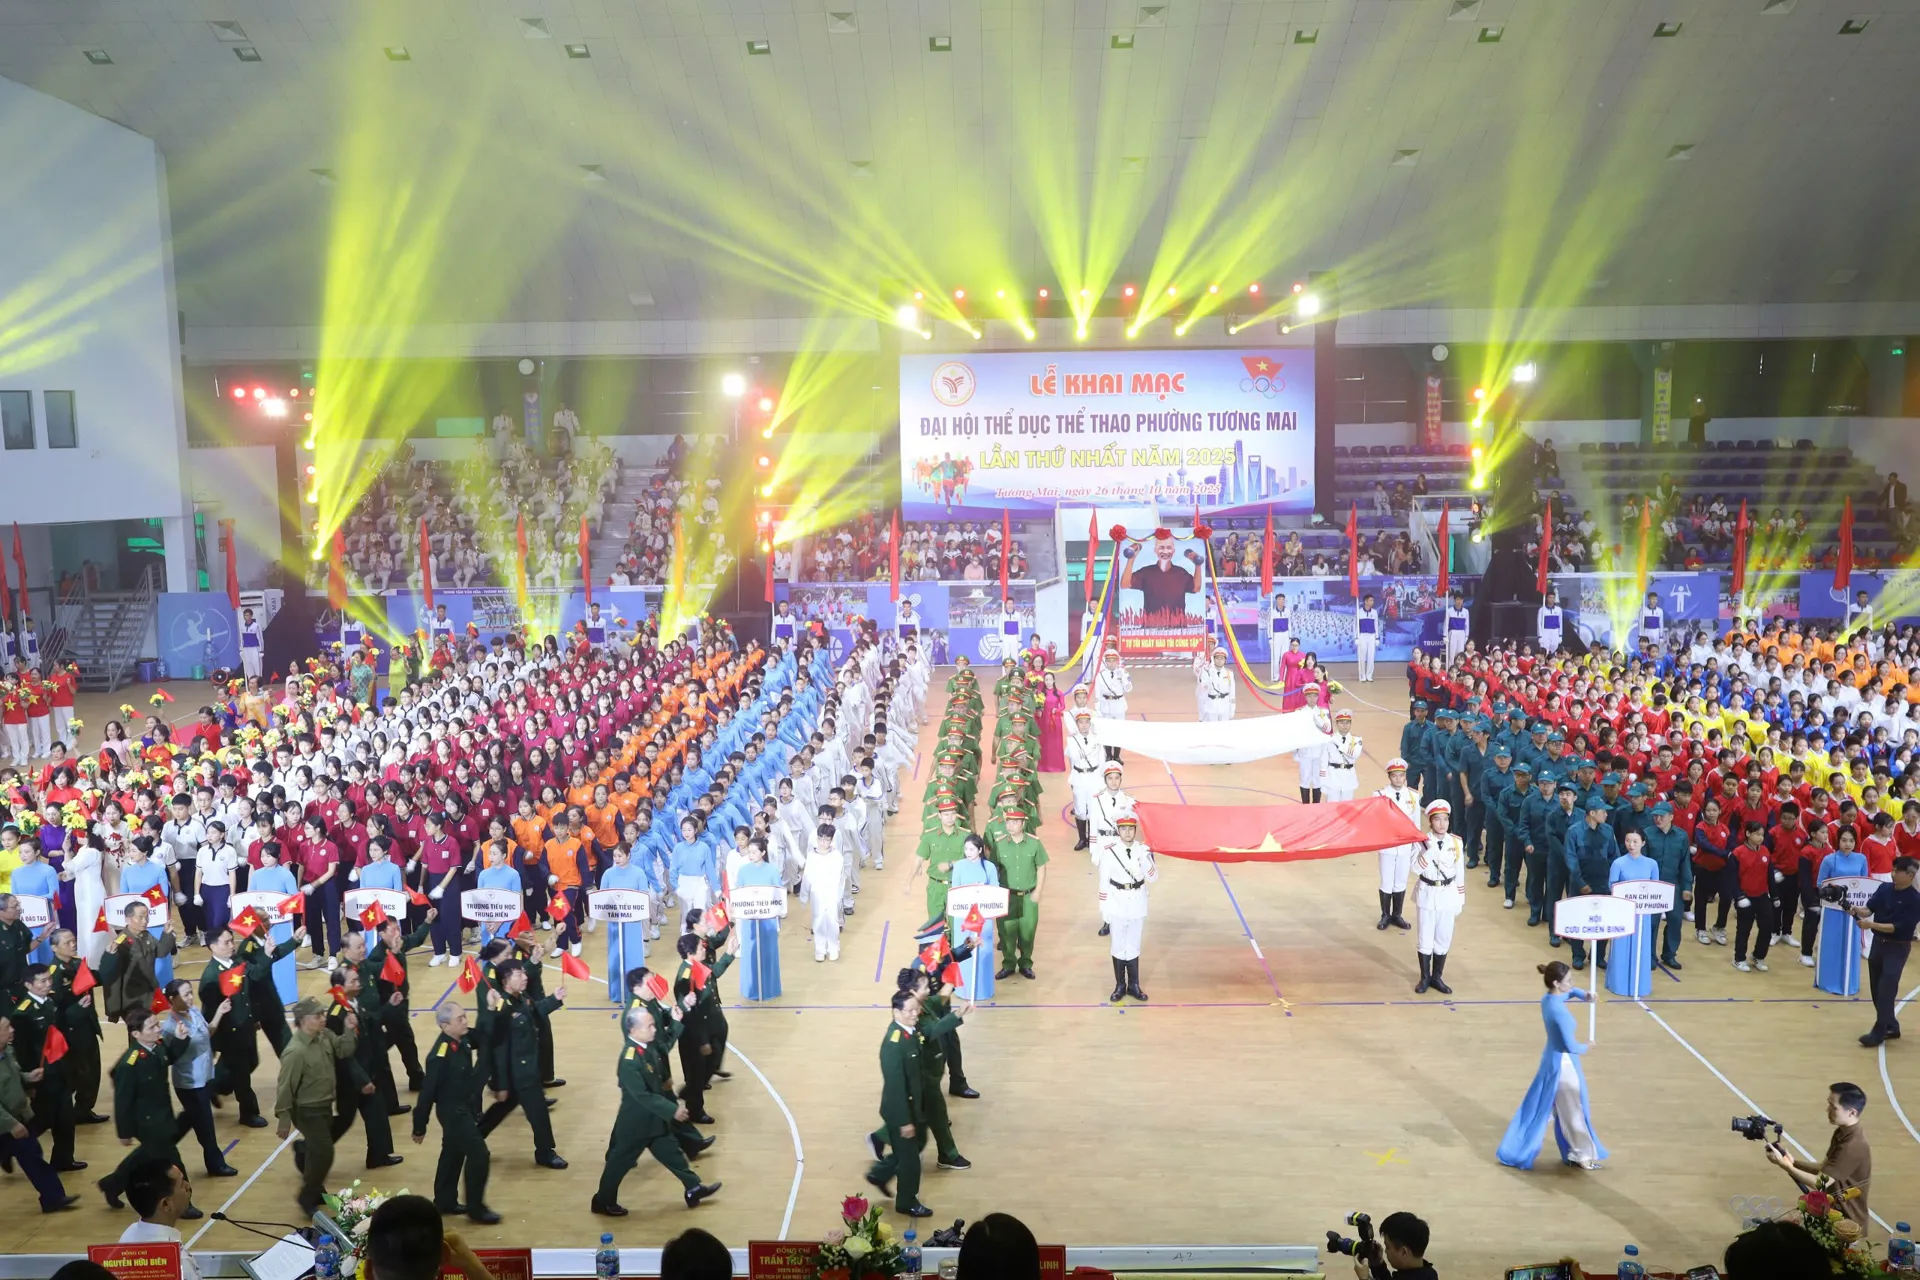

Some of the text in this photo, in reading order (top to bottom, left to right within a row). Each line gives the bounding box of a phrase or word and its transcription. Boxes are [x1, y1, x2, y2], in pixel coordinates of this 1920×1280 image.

[1030, 364, 1185, 401] LỄ KHAI MẠC
[920, 406, 1297, 440] ĐẠI HỘI THỂ DỤC THỂ THAO PHƯỜNG TƯƠNG MAI
[979, 441, 1236, 469] LẦN THỨ NHẤT NĂM 2025
[1065, 487, 1092, 497] ngày
[1095, 486, 1109, 496] 26
[1111, 485, 1145, 496] tháng
[1149, 485, 1161, 495] 10
[1165, 485, 1190, 494] năm
[1194, 484, 1221, 494] 2025
[103, 1257, 132, 1267] NGUYỄN
[759, 1253, 784, 1265] TRẦN
